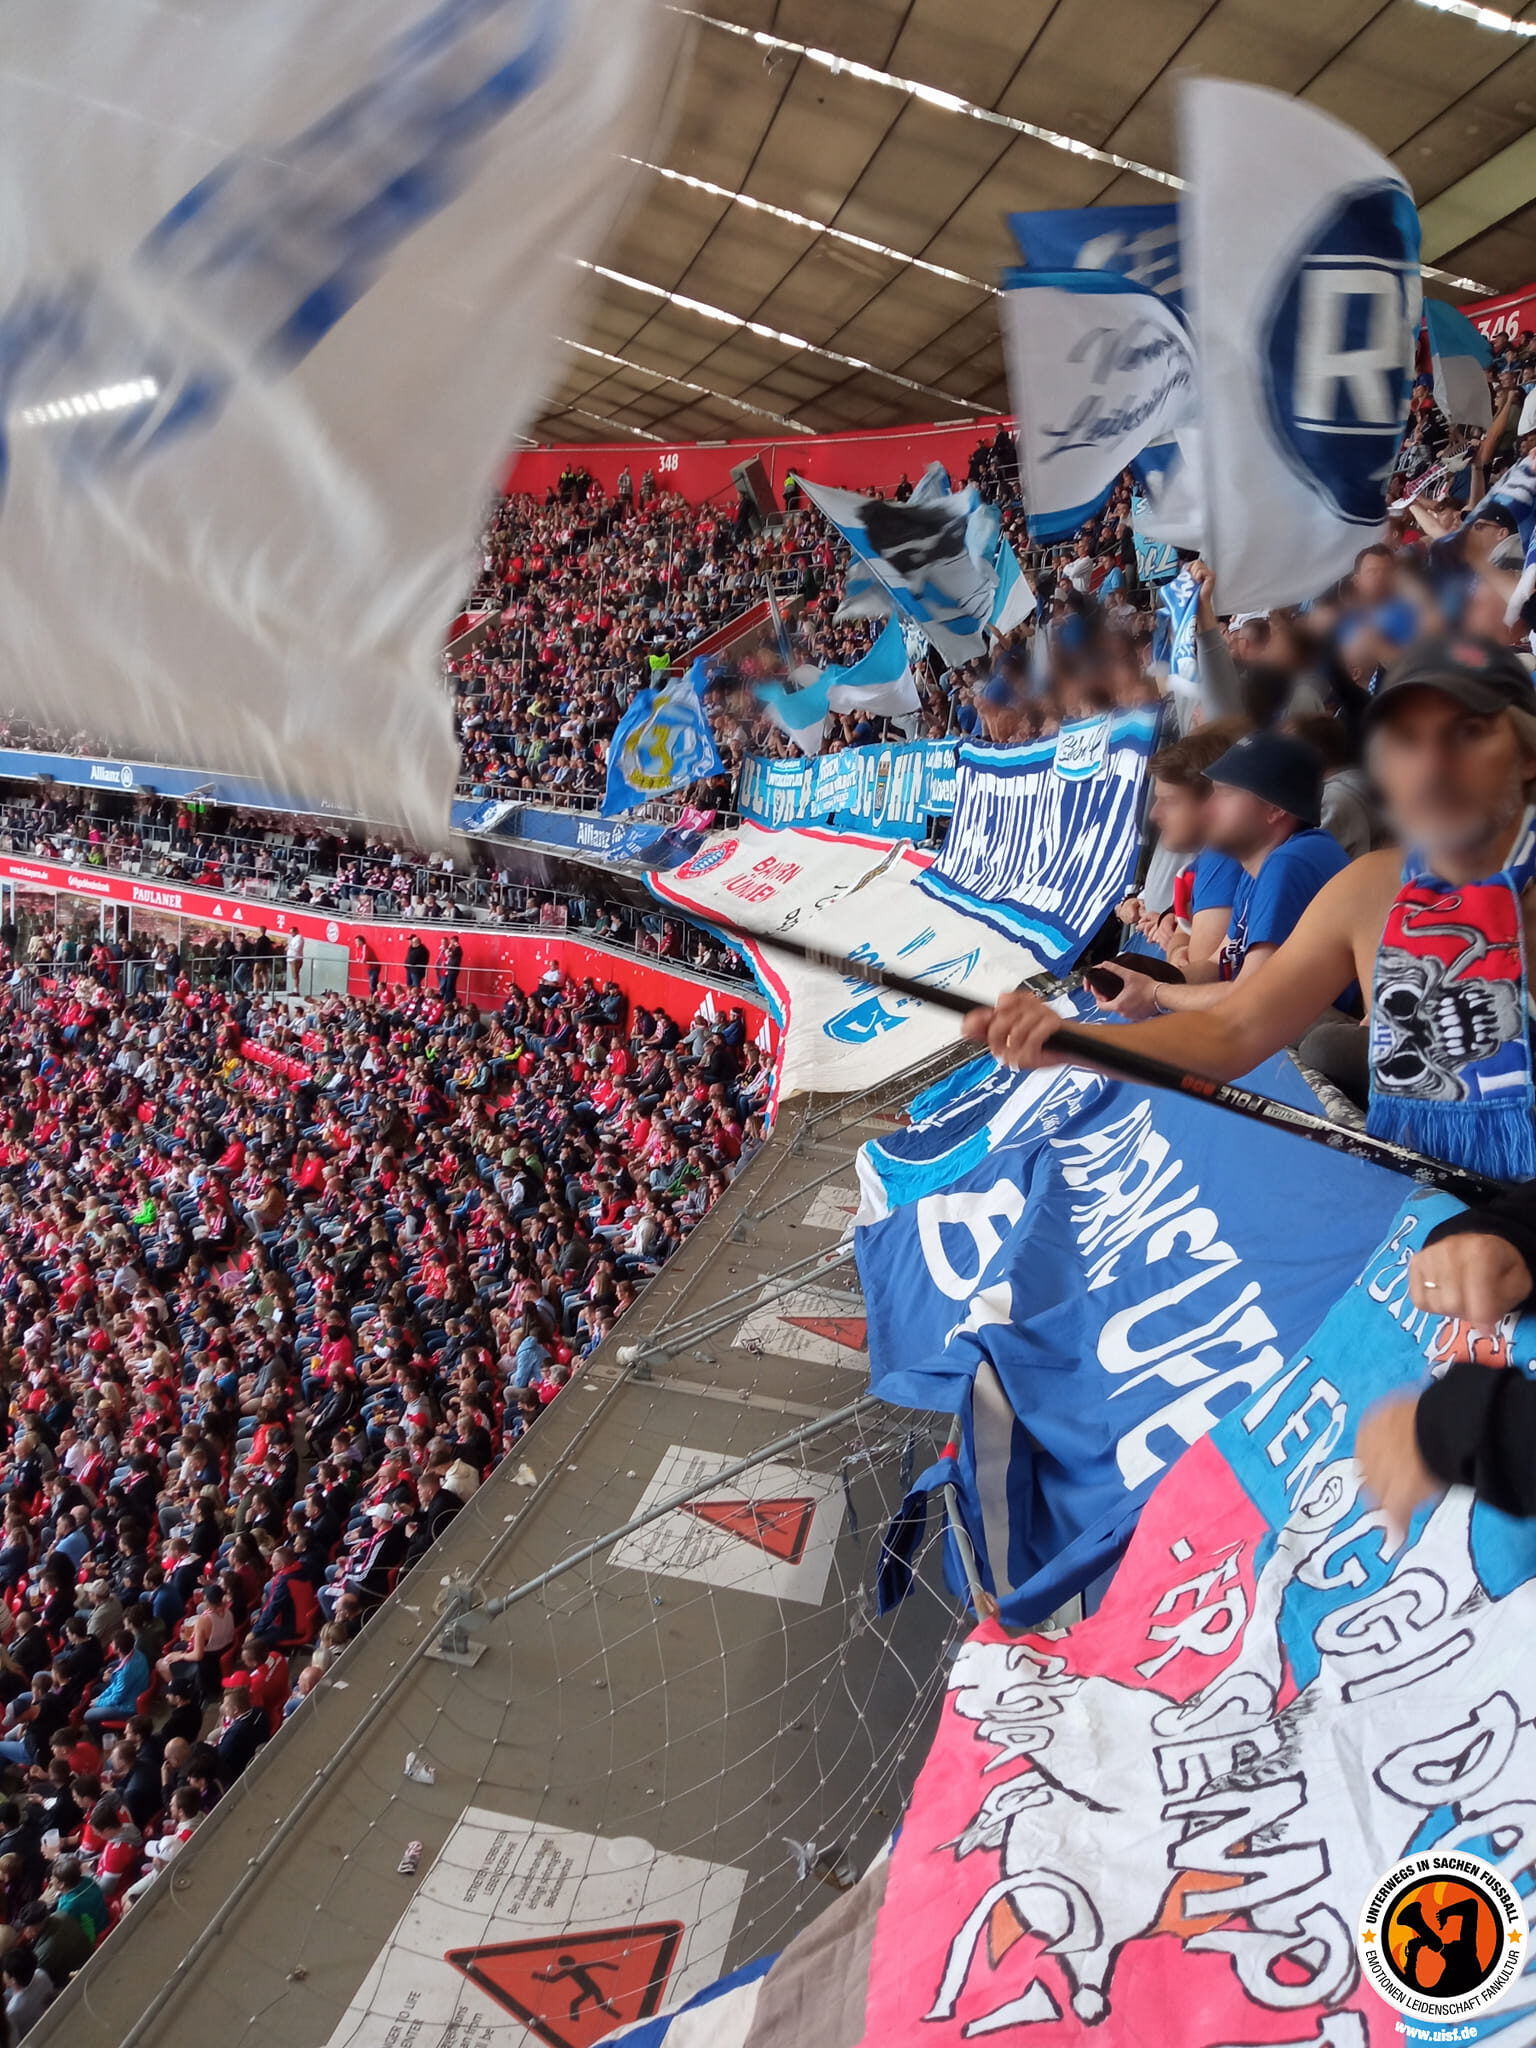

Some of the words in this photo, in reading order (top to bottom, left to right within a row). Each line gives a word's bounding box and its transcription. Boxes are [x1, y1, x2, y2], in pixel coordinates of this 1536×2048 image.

[658, 453, 679, 473] 348
[90, 764, 121, 783] Allianz
[577, 822, 611, 848] Allianz
[133, 887, 182, 909] PAULANER
[1218, 1084, 1265, 1111] POLE
[483, 1841, 518, 1896] LEBENSGEFAHR
[463, 1867, 490, 1903] BETRETEN
[396, 2009, 411, 2027] TO
[405, 1990, 421, 2015] LIFE
